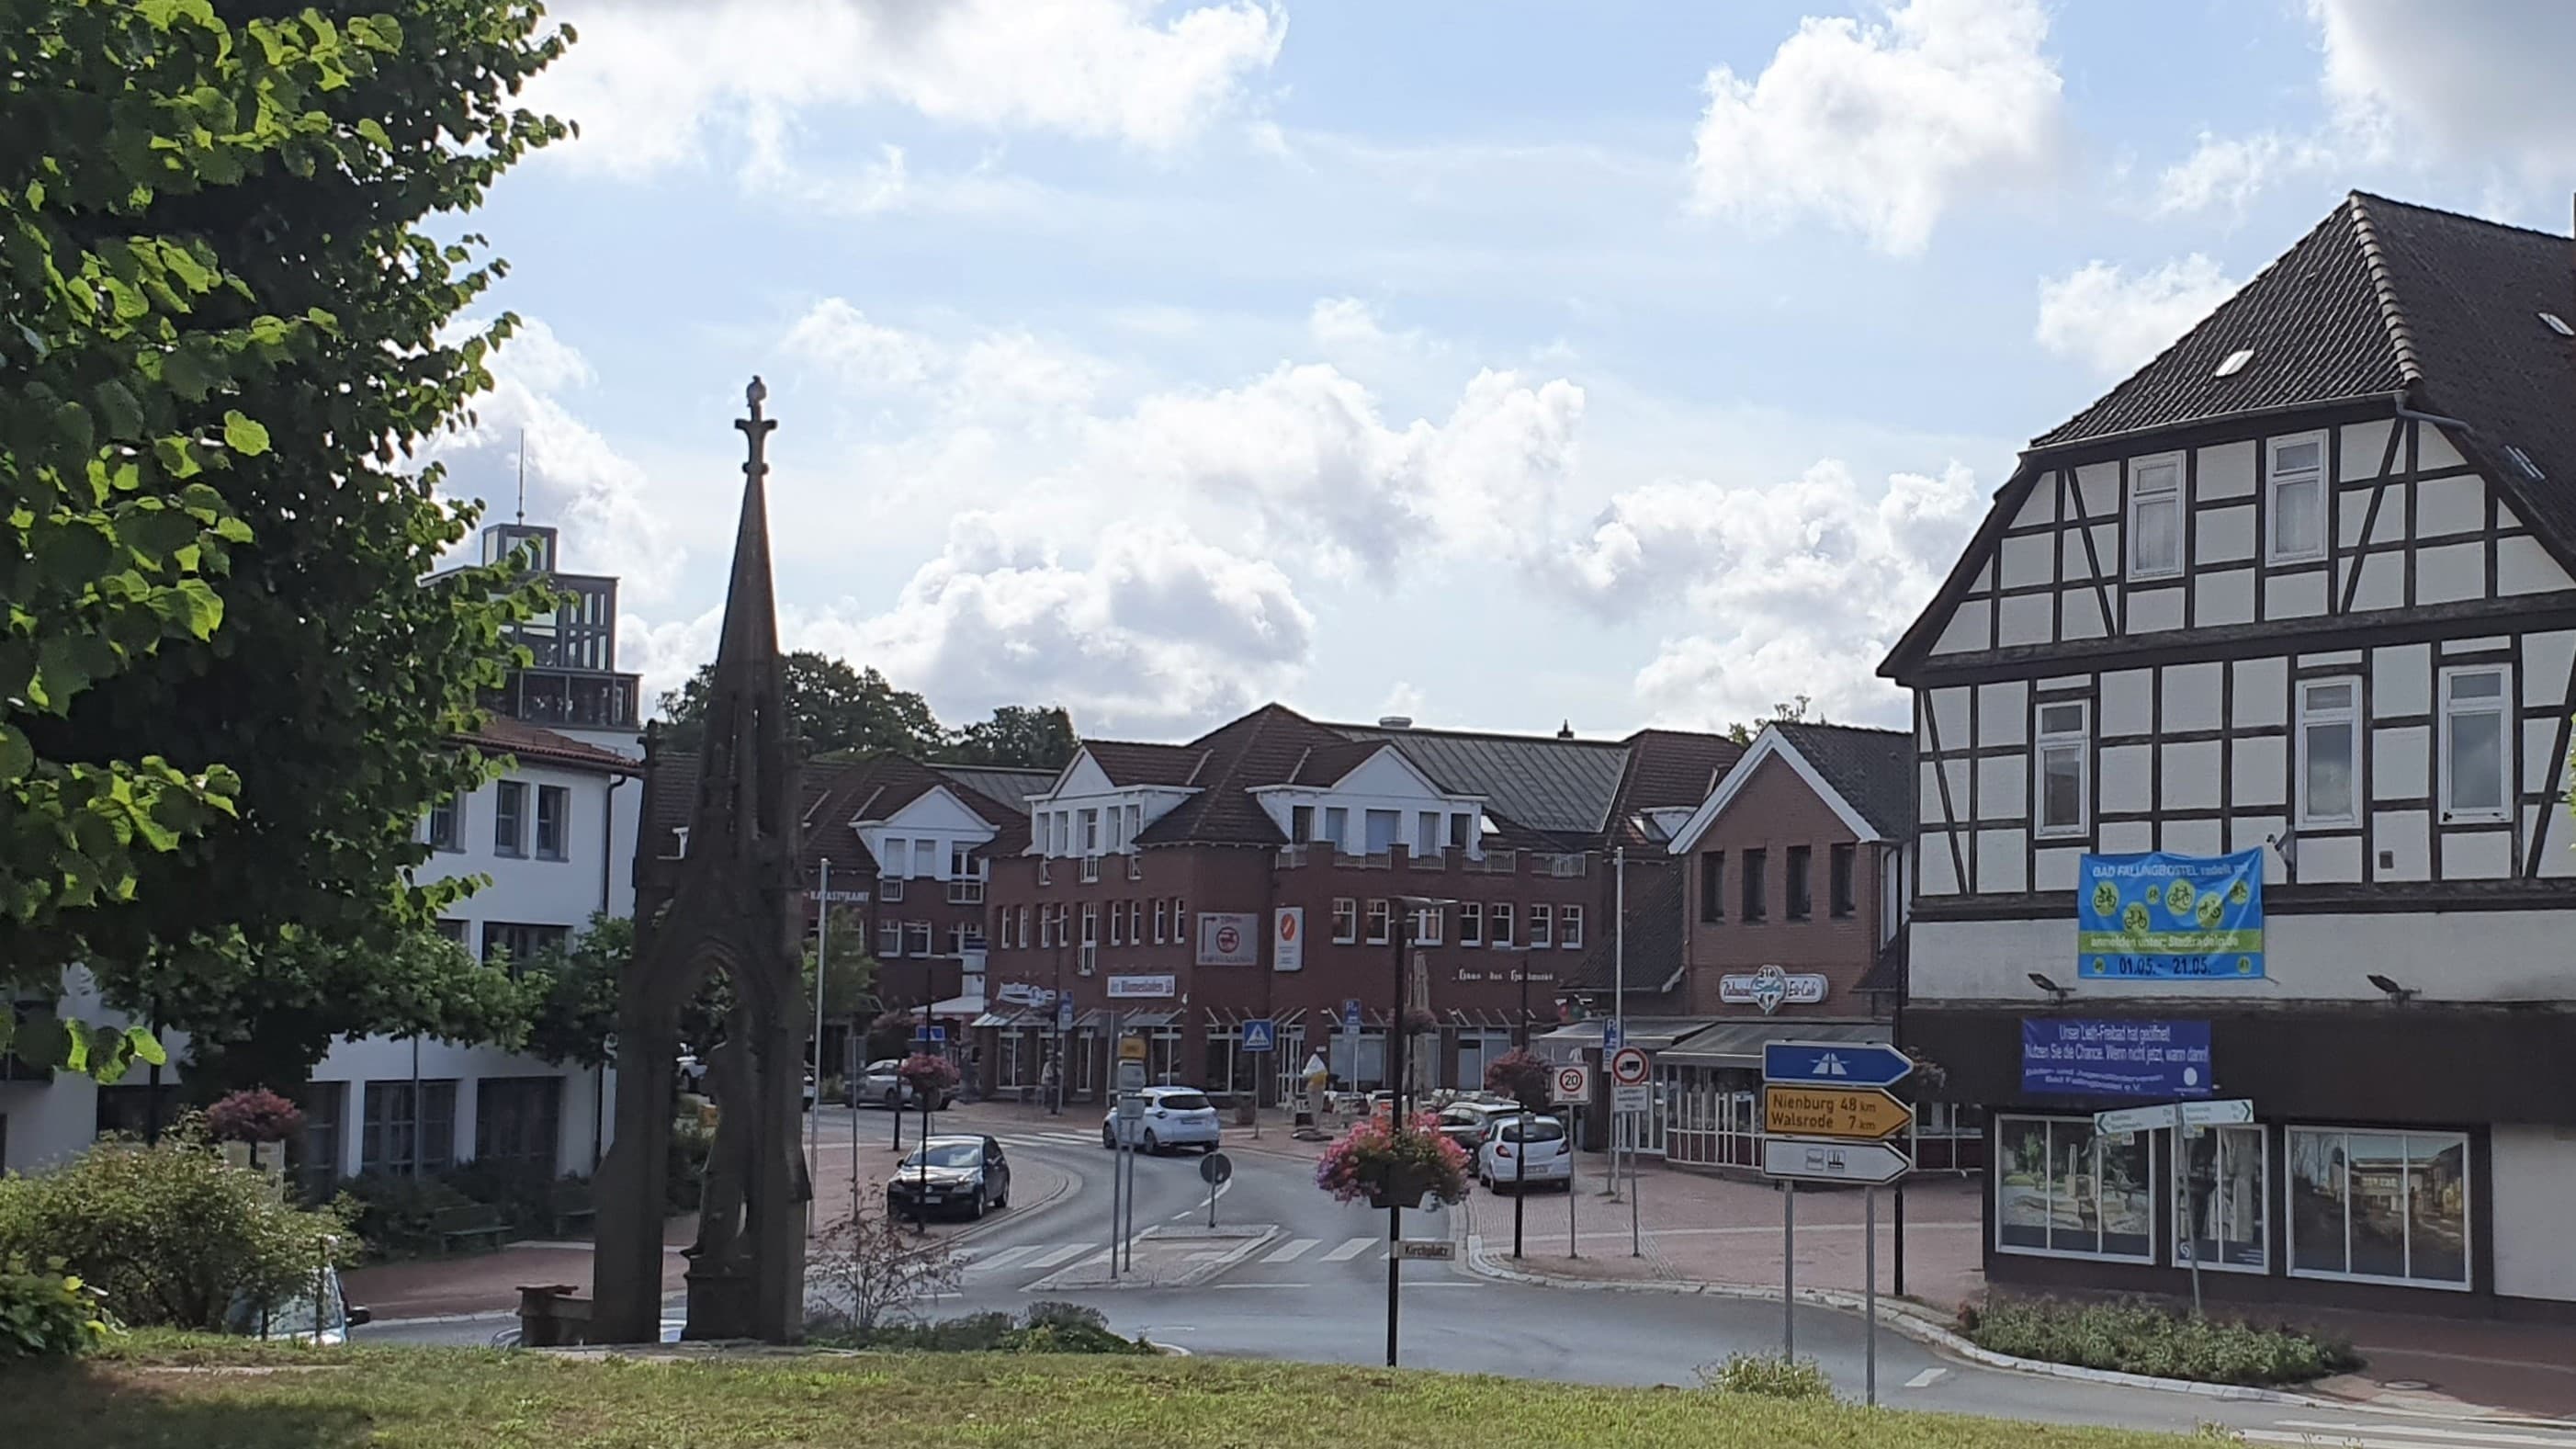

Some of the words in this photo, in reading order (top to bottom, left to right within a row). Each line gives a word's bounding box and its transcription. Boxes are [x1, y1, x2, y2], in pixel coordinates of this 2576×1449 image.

[2093, 866, 2116, 877] BAD
[2118, 865, 2198, 877] FALLINGBOSTEL
[2173, 957, 2212, 975] 21.05.
[2051, 1044, 2062, 1059] Sie
[1565, 1075, 1577, 1086] 20
[1773, 1093, 1835, 1114] Nienburg
[1840, 1097, 1857, 1111] 48
[1860, 1102, 1876, 1113] km
[1771, 1112, 1834, 1129] Walsrode
[1848, 1115, 1857, 1129] 7
[1859, 1119, 1876, 1130] km
